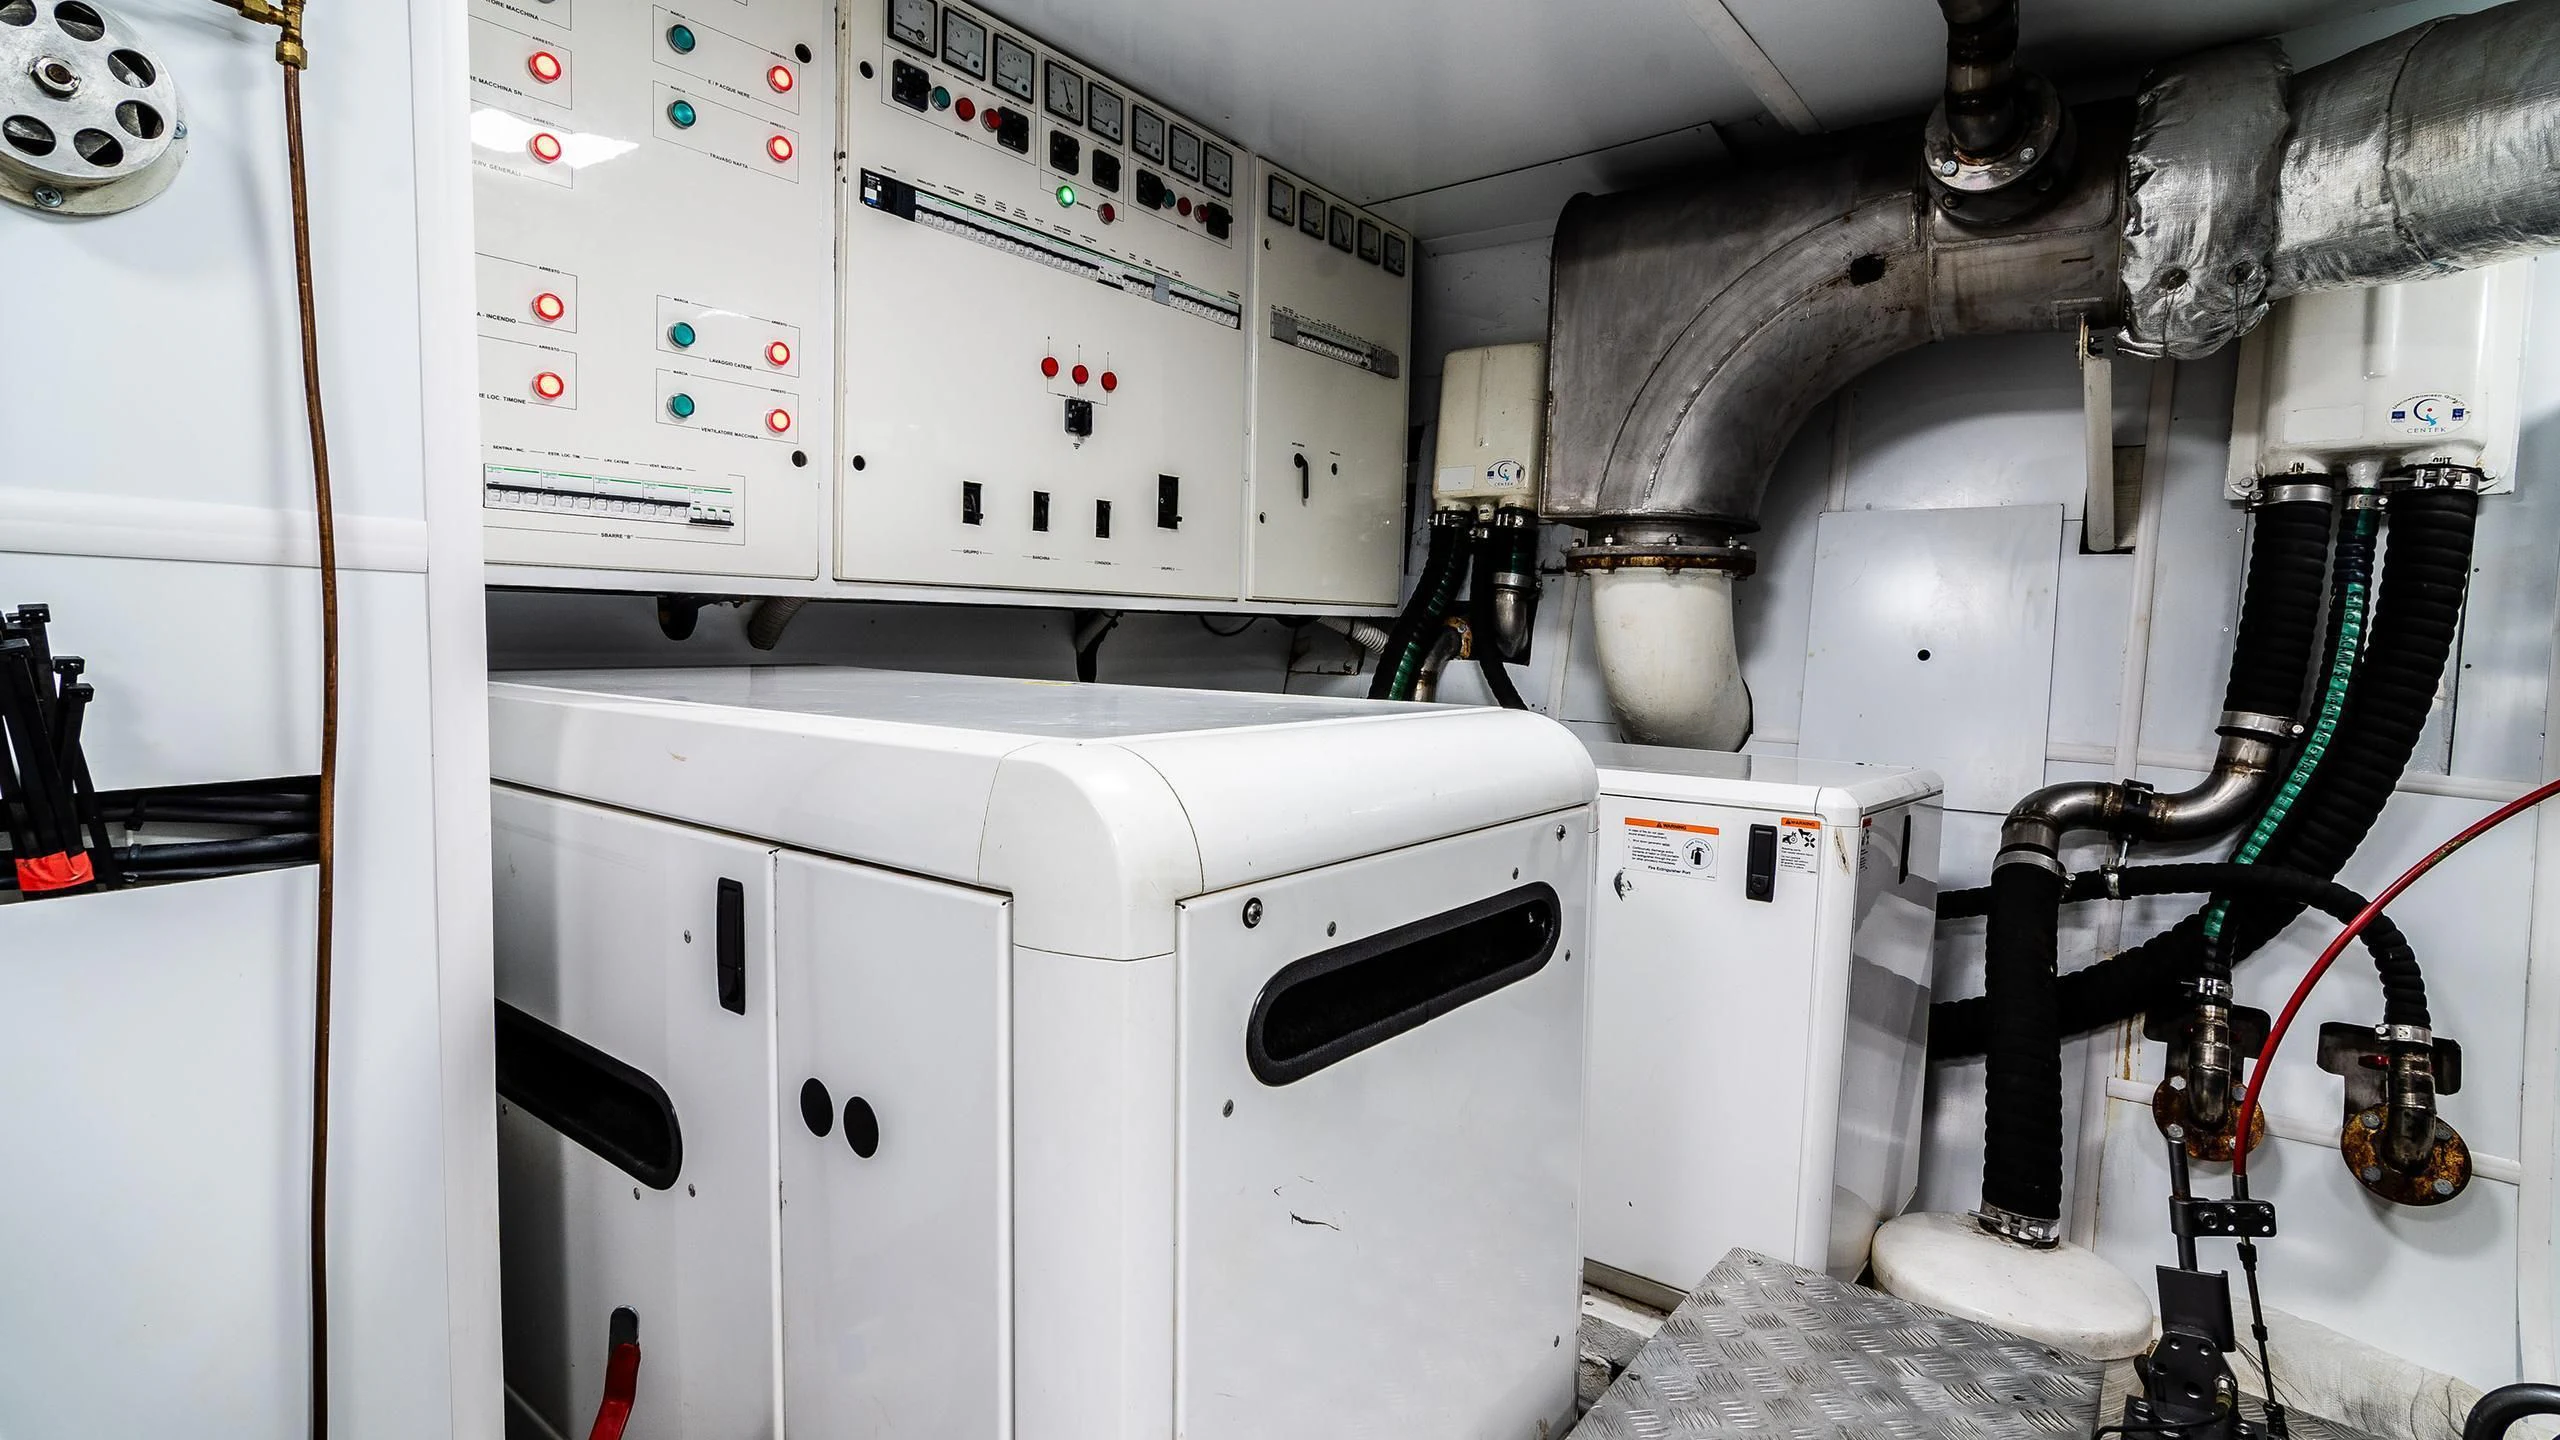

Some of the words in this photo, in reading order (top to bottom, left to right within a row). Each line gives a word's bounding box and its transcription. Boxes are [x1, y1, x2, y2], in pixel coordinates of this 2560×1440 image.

[506, 4, 539, 20] MACCHINA
[478, 77, 512, 93] MACCHINA
[472, 160, 488, 168] ERV.
[486, 313, 516, 324] INCENDIO
[709, 358, 734, 368] LAVAGGIO
[734, 362, 753, 371] CATENE
[503, 396, 526, 404] TIMONE
[701, 427, 733, 436] VENTILATORE
[734, 432, 759, 440] MACCHINA
[2291, 463, 2304, 473] IN
